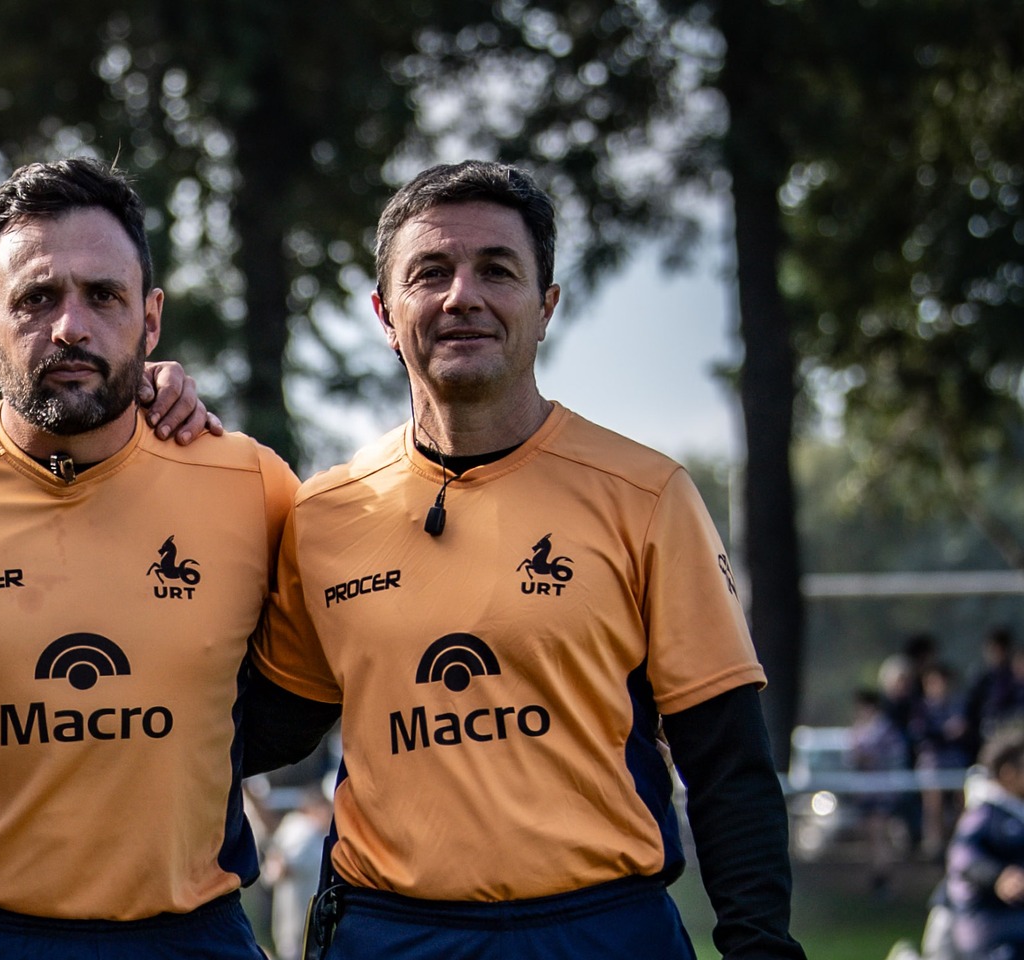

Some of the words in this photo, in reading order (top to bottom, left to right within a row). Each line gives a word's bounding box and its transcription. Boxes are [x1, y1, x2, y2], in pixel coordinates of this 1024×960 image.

[153, 586, 196, 600] URT
[324, 569, 401, 608] PROCER
[520, 581, 568, 597] URT
[0, 701, 174, 746] Macro
[389, 704, 551, 755] Macro
